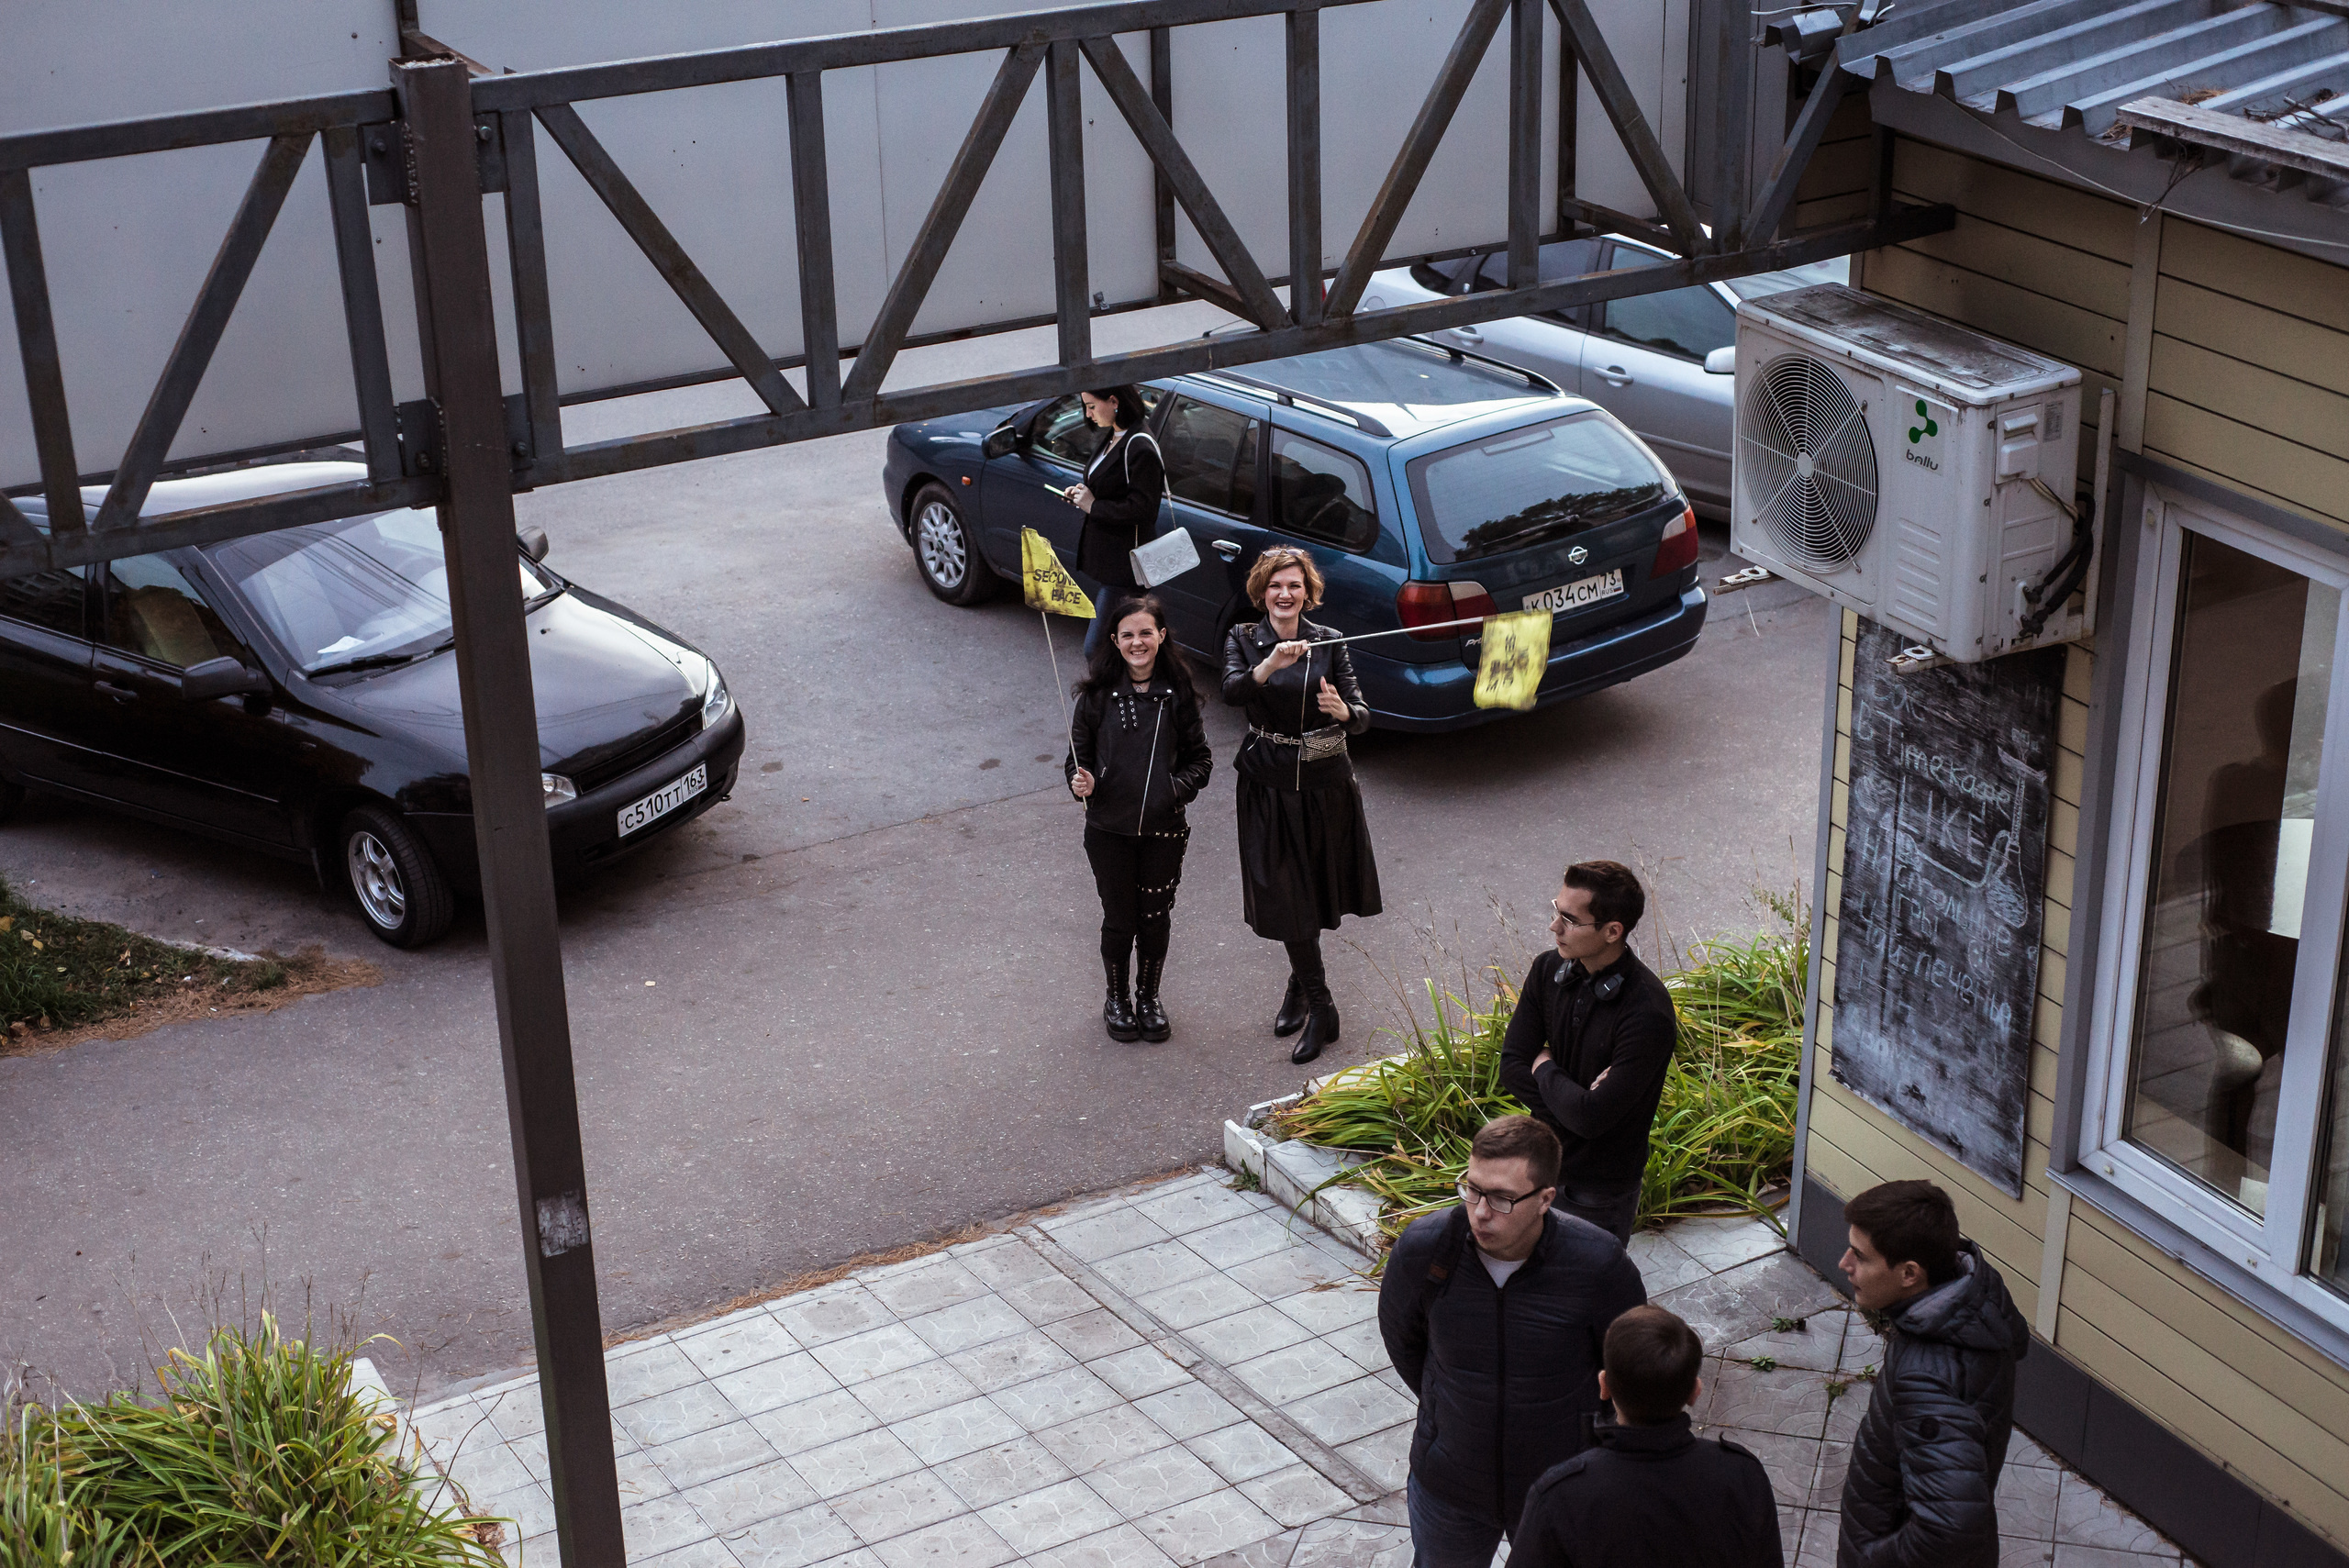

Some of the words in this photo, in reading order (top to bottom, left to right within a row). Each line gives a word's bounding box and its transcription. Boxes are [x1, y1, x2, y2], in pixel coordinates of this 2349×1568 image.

[1600, 573, 1617, 589] 73
[684, 768, 705, 791] 163
[688, 787, 698, 796] RUS
[1897, 774, 1986, 867] LIKE
